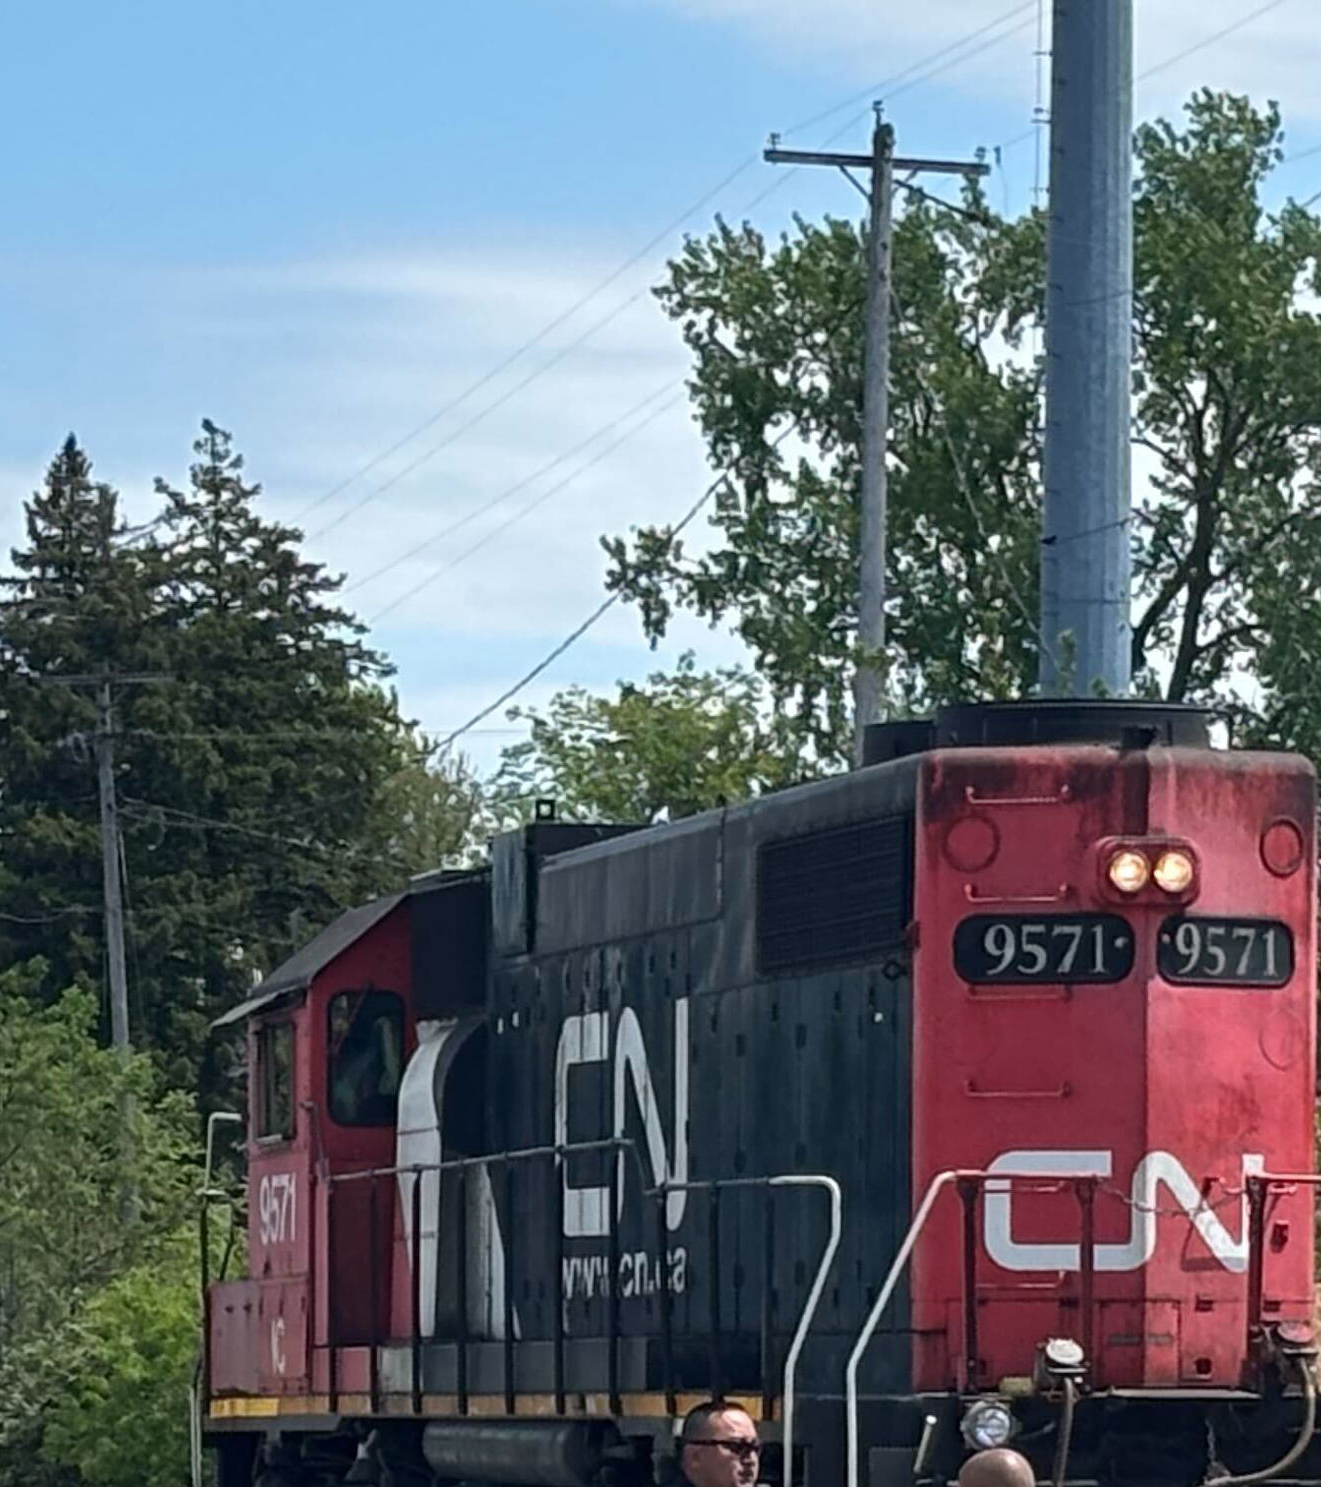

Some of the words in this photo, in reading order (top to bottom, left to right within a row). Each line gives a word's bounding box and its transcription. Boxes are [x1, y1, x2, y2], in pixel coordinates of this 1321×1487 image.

[983, 923, 1108, 975] 9571
[1177, 922, 1278, 977] 9571
[555, 997, 689, 1237] CN
[259, 1172, 297, 1246] 9571
[984, 1150, 1264, 1273] CN
